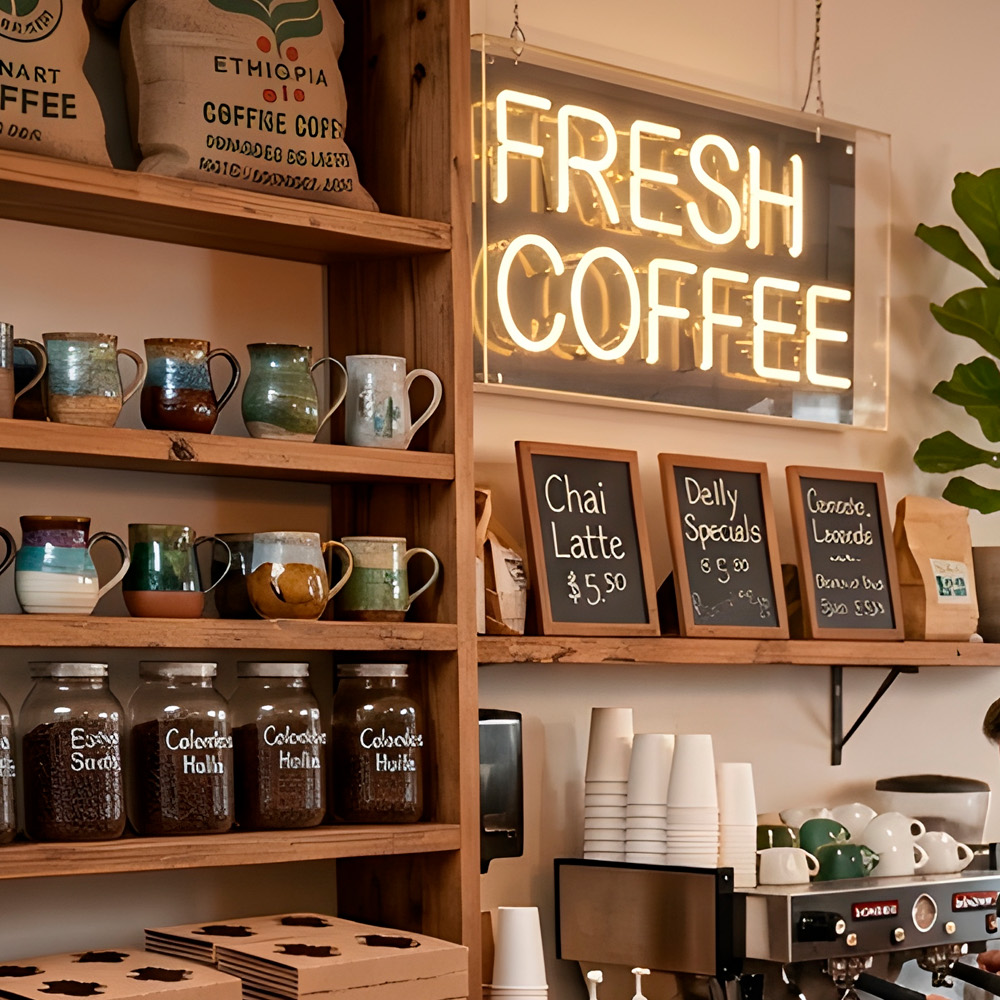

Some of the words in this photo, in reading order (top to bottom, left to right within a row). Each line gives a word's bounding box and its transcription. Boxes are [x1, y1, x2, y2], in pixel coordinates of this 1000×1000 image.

[214, 55, 328, 87] ETHIOPIA
[493, 89, 803, 258] FRESH
[497, 234, 852, 389] COFFEE
[545, 474, 606, 514] Chai
[551, 521, 625, 559] Latte
[684, 513, 762, 550] Specials
